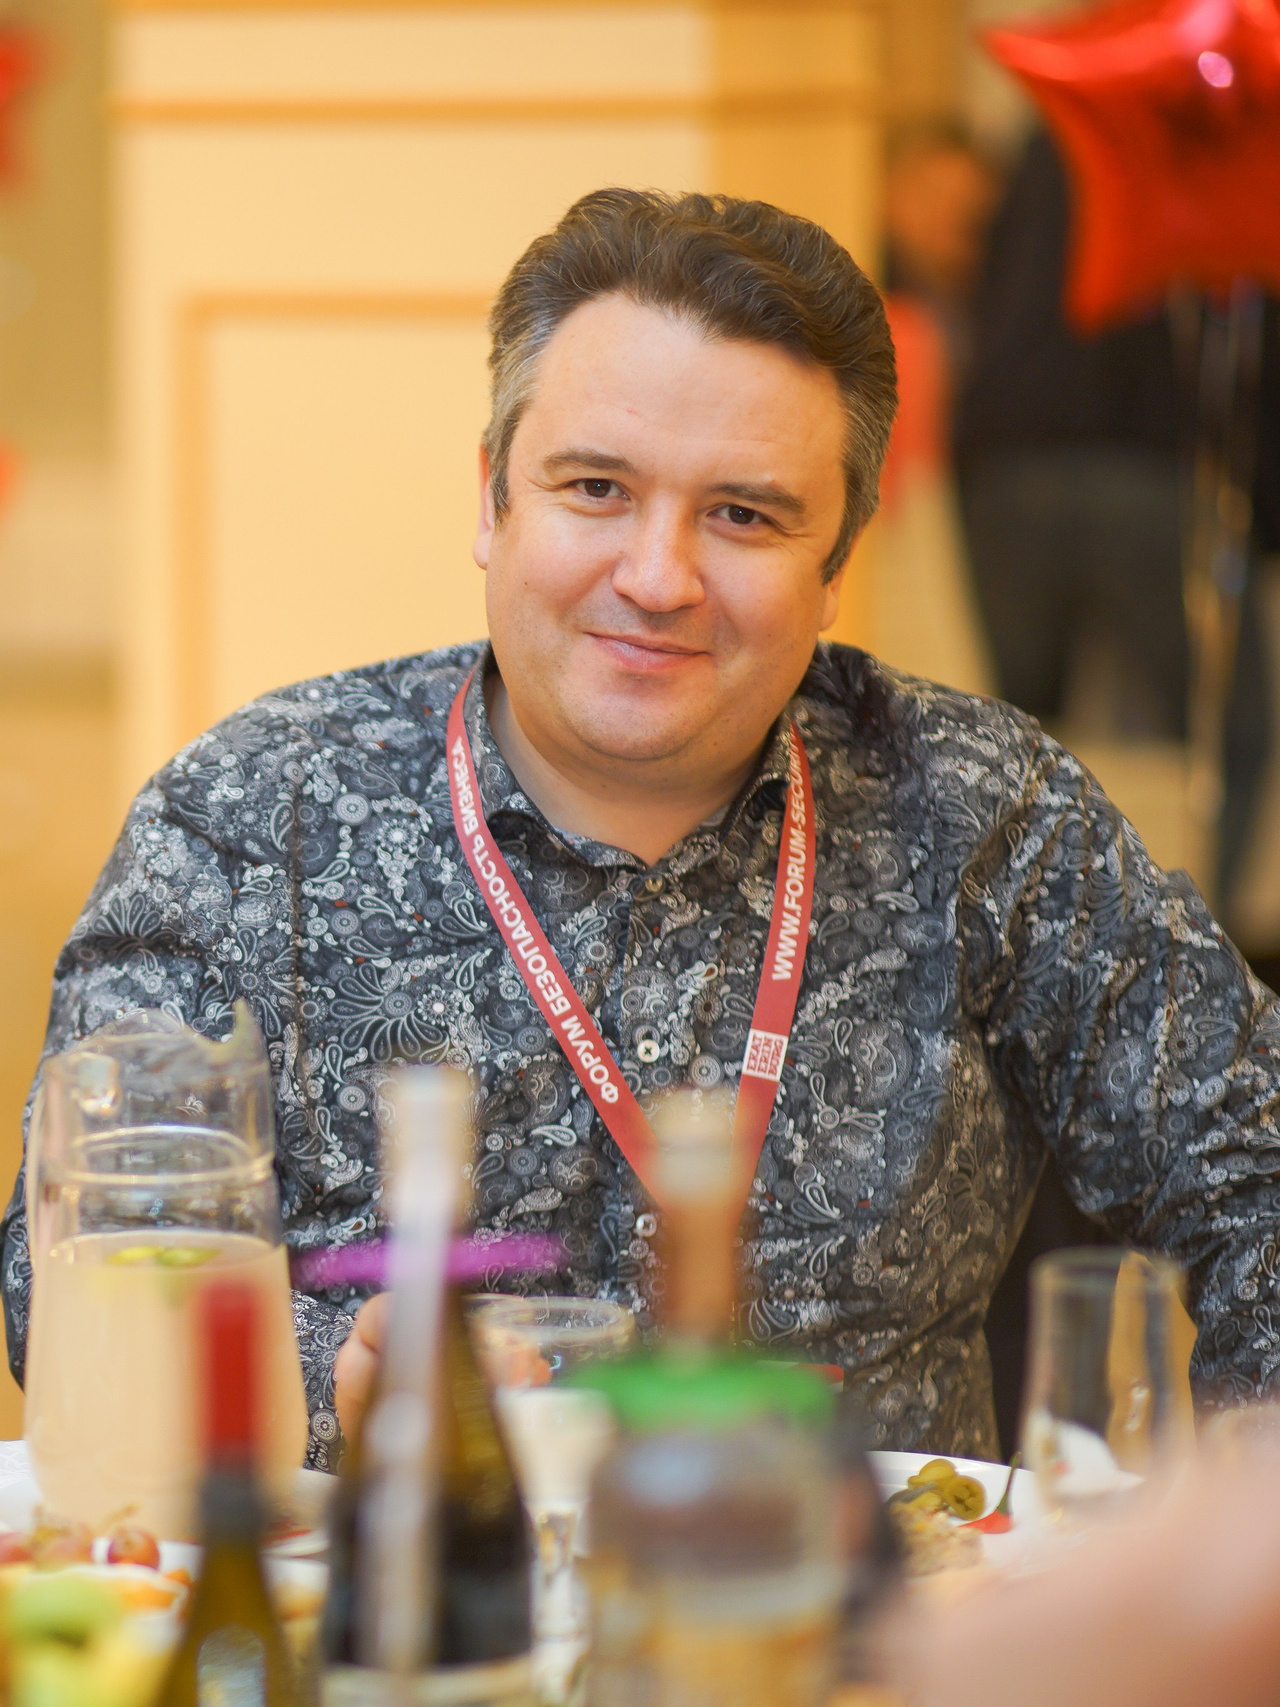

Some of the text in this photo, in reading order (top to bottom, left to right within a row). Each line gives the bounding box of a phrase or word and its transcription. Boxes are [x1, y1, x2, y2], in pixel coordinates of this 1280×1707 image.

[451, 735, 619, 1104] ФОРУМ БЕЗОПАСНОСТЬ БИЗНЕСА
